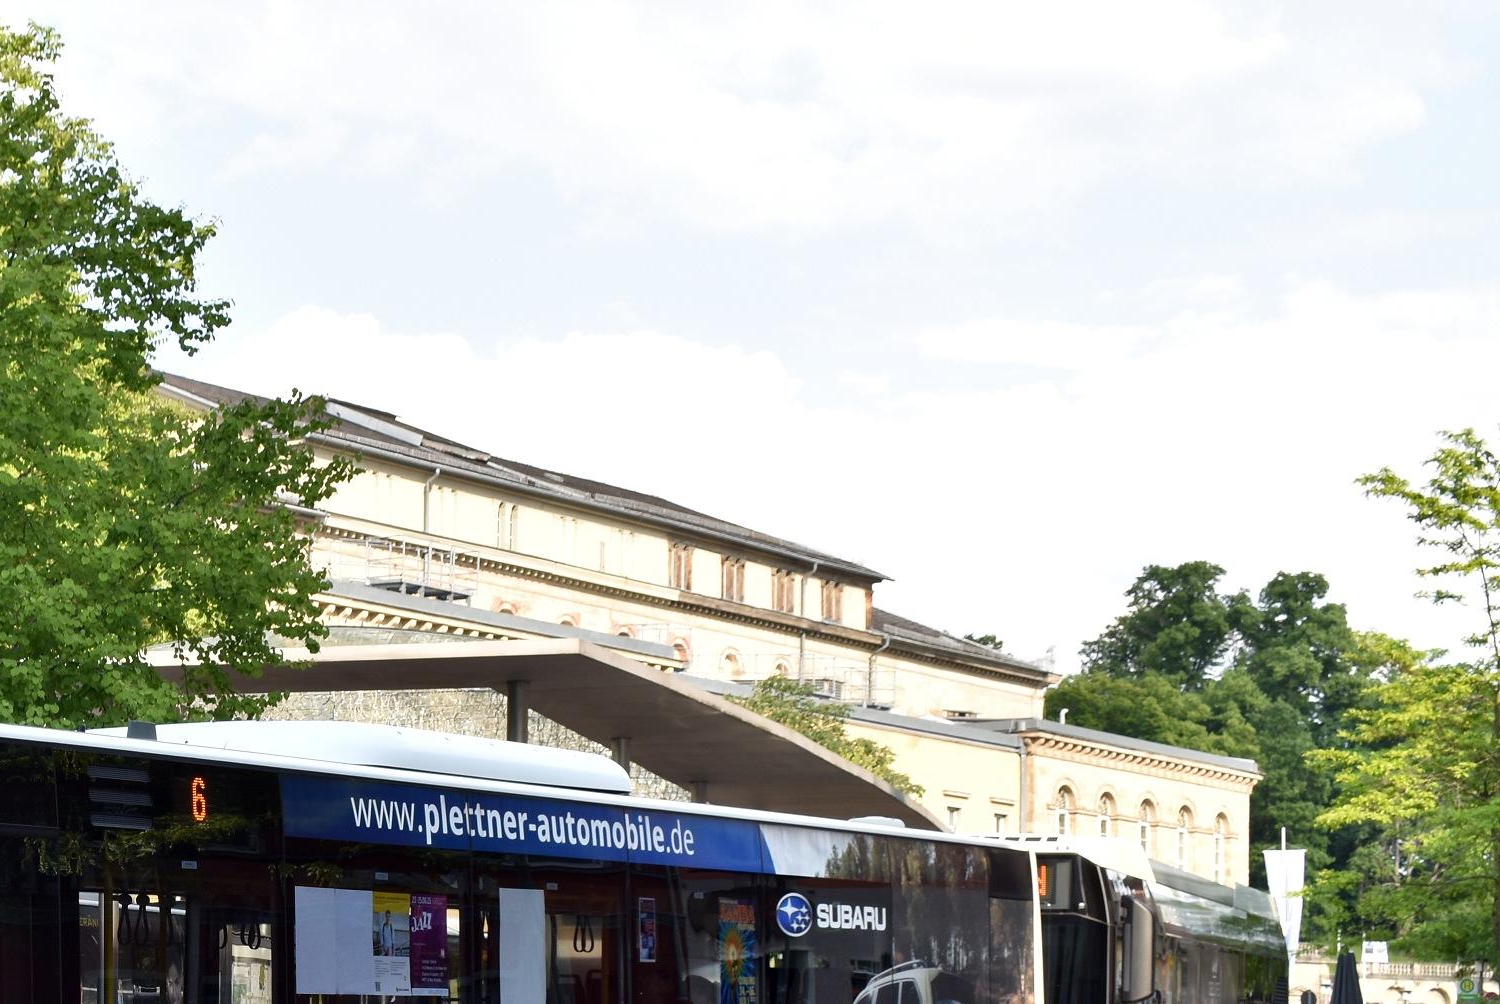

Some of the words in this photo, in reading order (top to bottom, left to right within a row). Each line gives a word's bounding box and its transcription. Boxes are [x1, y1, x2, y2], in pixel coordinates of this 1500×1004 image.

[191, 776, 206, 822] 6
[350, 794, 695, 855] www.plettner-automobile.de
[816, 903, 887, 932] SUBARU
